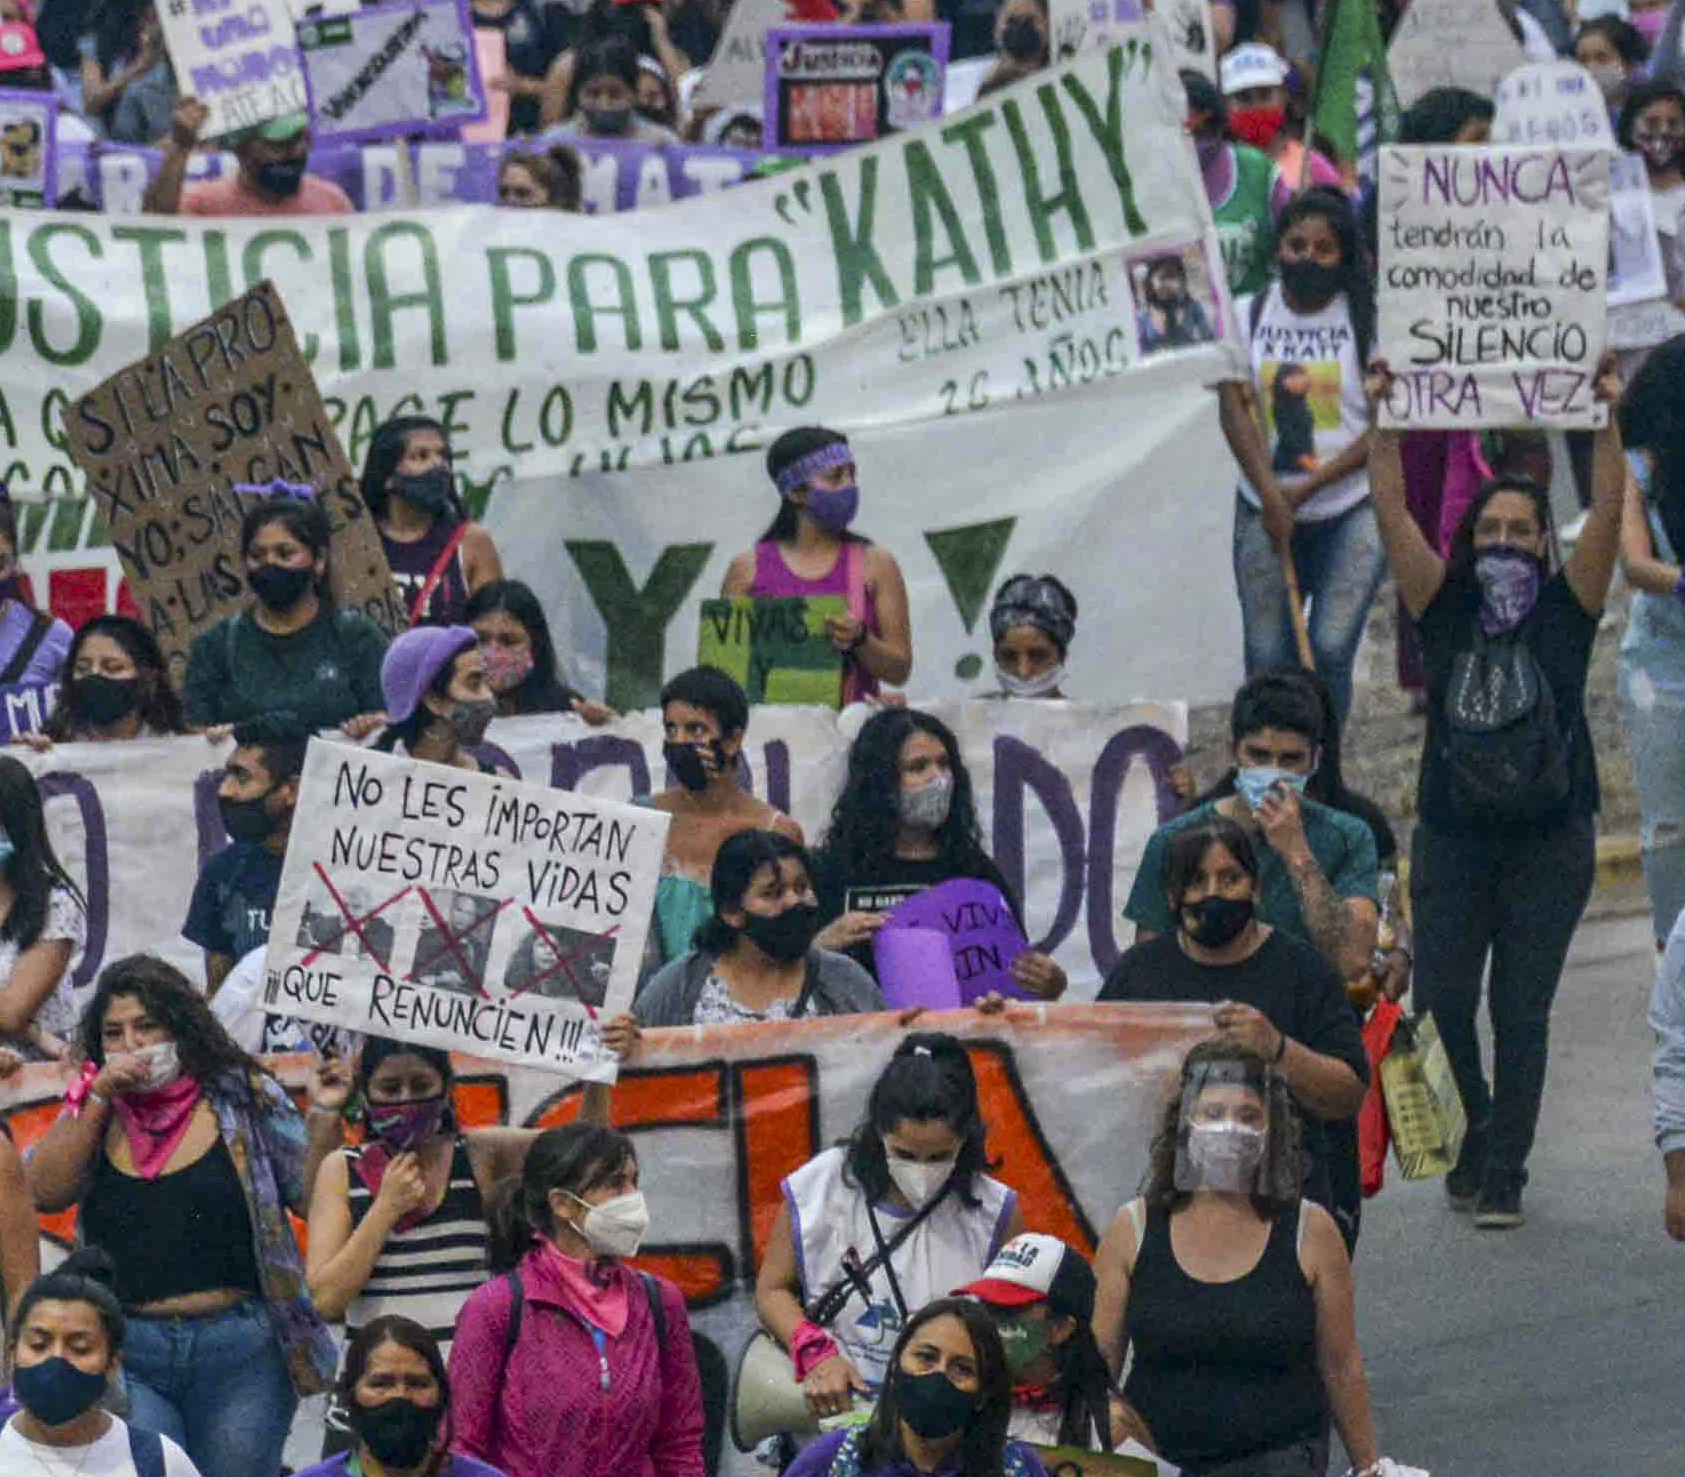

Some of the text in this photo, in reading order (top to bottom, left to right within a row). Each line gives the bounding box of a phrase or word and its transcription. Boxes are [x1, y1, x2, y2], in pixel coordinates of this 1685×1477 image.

[1422, 154, 1576, 208] NUNCA
[1390, 216, 1571, 251] tendrán la
[485, 232, 801, 363] PARA
[1388, 258, 1598, 294] comodidad de
[1446, 292, 1552, 322] nuestro
[501, 354, 818, 451] LO MISMO
[1383, 369, 1483, 422] OTRA
[95, 432, 200, 515] XIMA
[402, 774, 467, 827] LES
[330, 826, 502, 890] NUESTRAS
